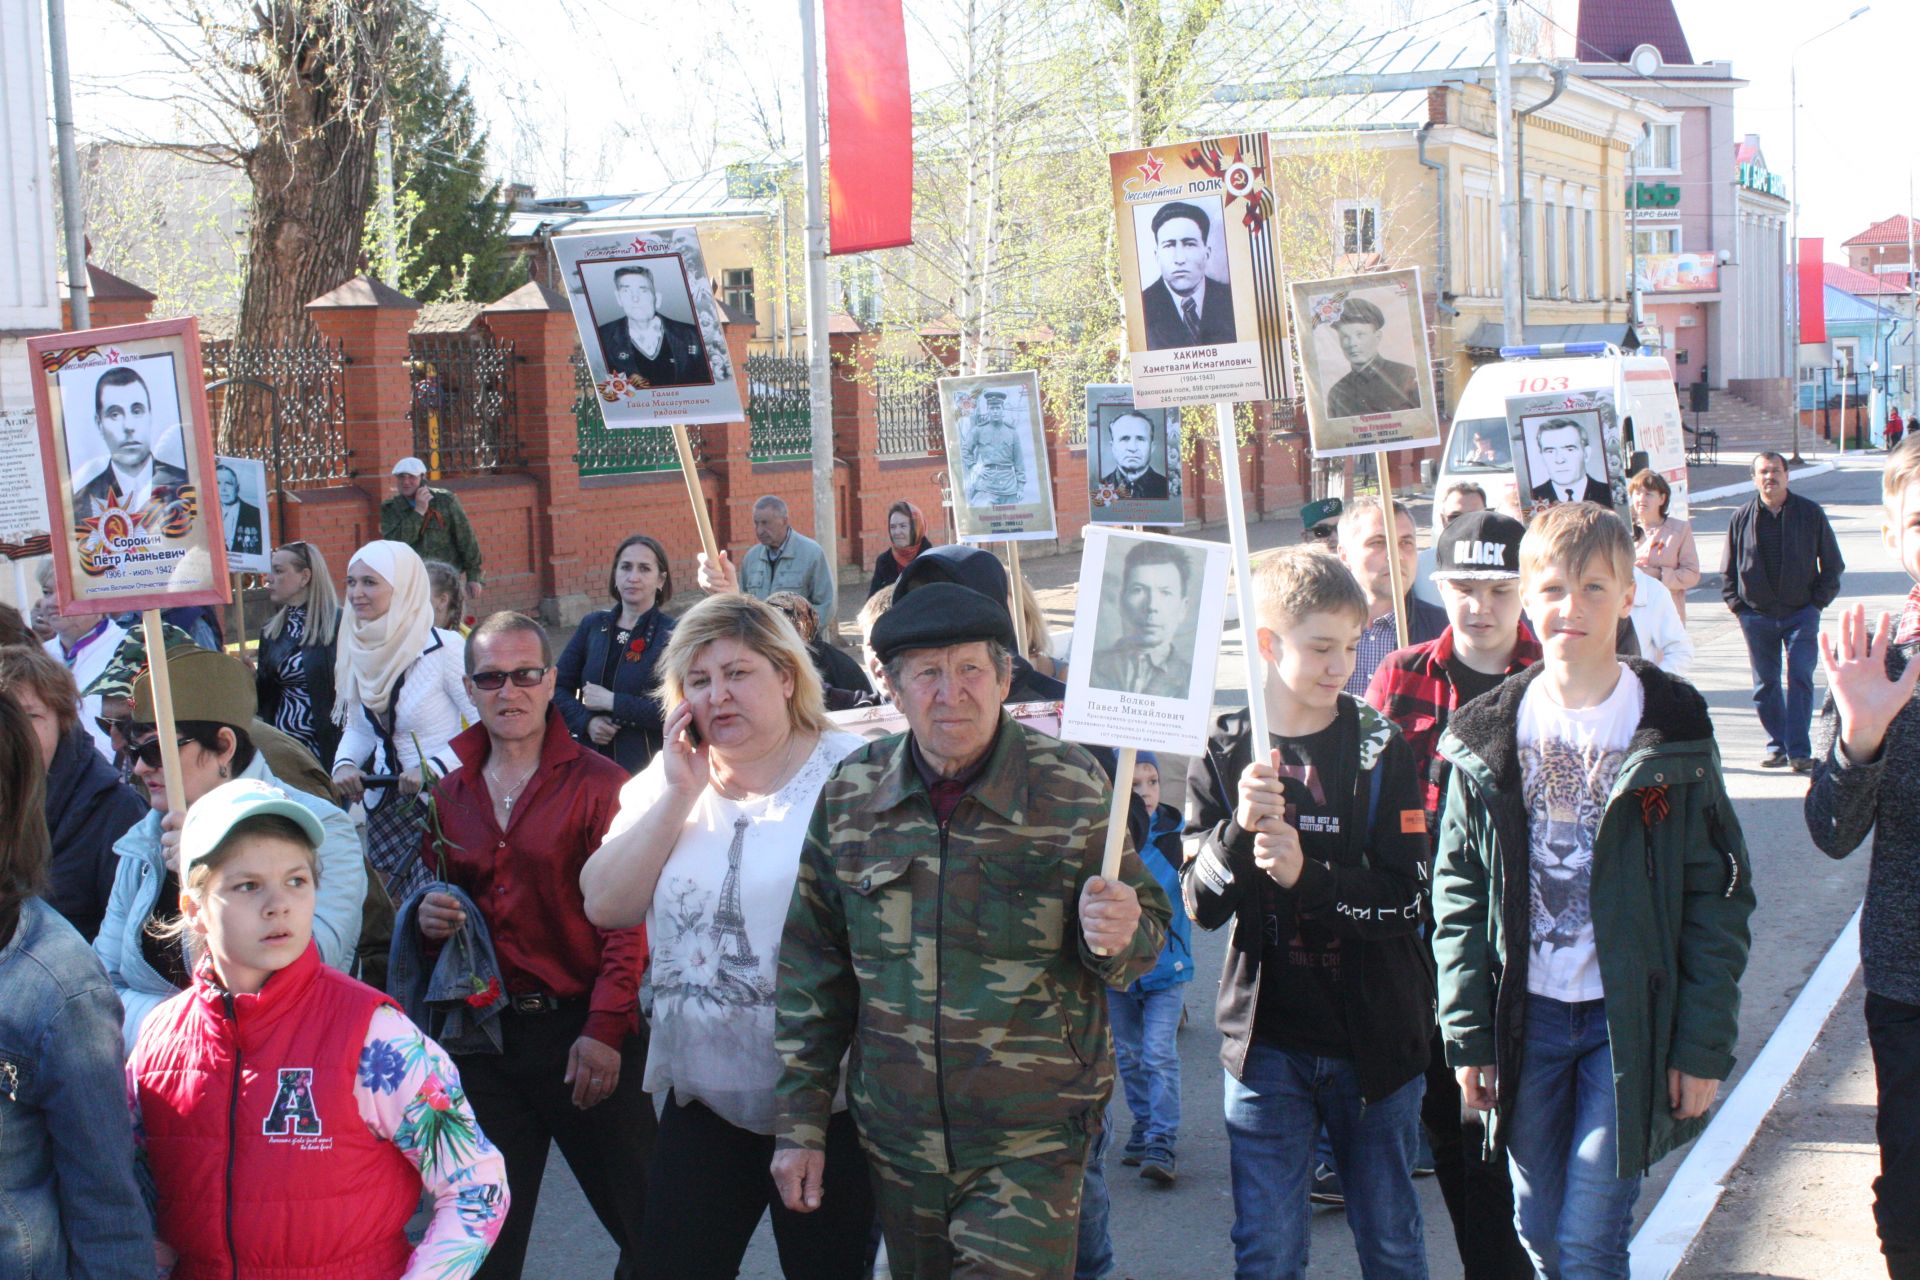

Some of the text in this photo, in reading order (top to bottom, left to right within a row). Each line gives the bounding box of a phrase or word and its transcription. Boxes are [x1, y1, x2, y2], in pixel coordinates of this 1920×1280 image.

[1189, 179, 1222, 192] ПОЛК
[1173, 348, 1218, 360] ХАКИМОВ
[1143, 358, 1252, 374] Хаметвали Исмагилович
[1180, 373, 1216, 383] (1904-1943)
[1519, 376, 1569, 393] 103
[1204, 381, 1244, 391] стрелковый
[1173, 394, 1210, 402] стрелковая
[114, 535, 161, 548] Сорокин
[94, 549, 186, 566] Пётр Ананьевич
[1454, 540, 1506, 566] BLACK
[105, 570, 122, 579] 1906
[133, 569, 153, 577] июль
[155, 565, 172, 574] 1942
[111, 583, 135, 591] Великой
[1120, 694, 1156, 707] Волков
[1087, 701, 1185, 721] Павел Михайлович
[263, 1068, 321, 1135] A
